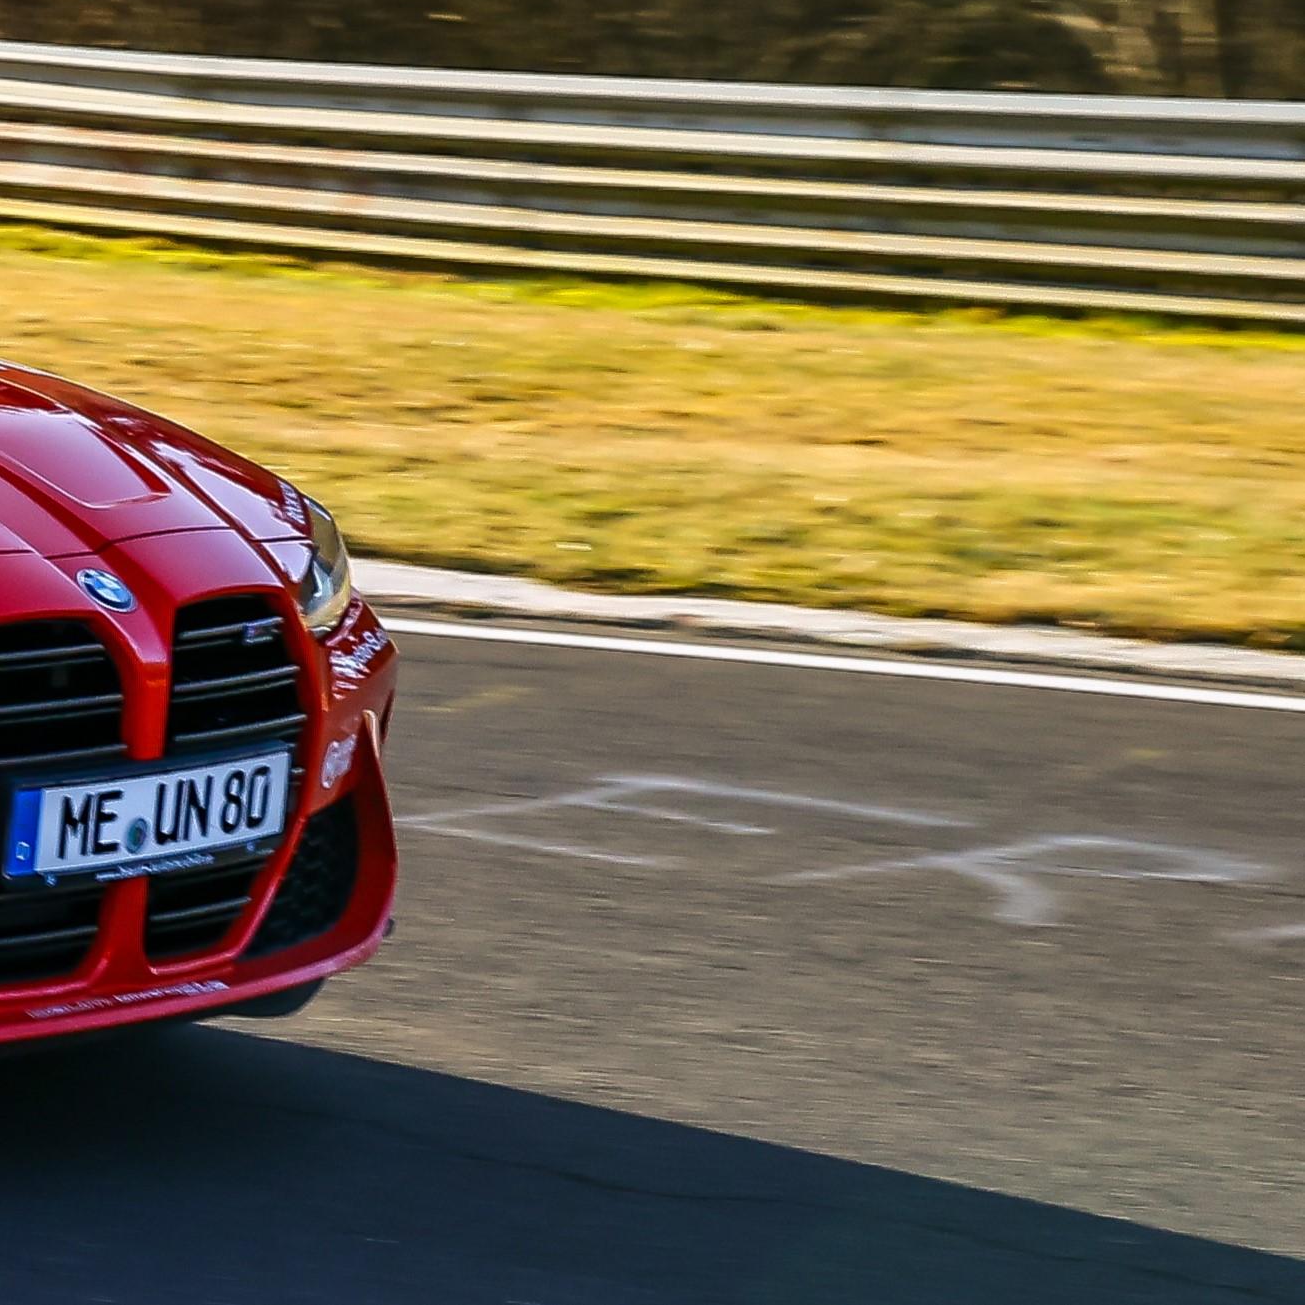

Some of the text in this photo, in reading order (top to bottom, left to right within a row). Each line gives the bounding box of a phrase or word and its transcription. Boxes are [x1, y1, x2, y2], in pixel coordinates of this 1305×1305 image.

[58, 765, 271, 860] ME UN 80
